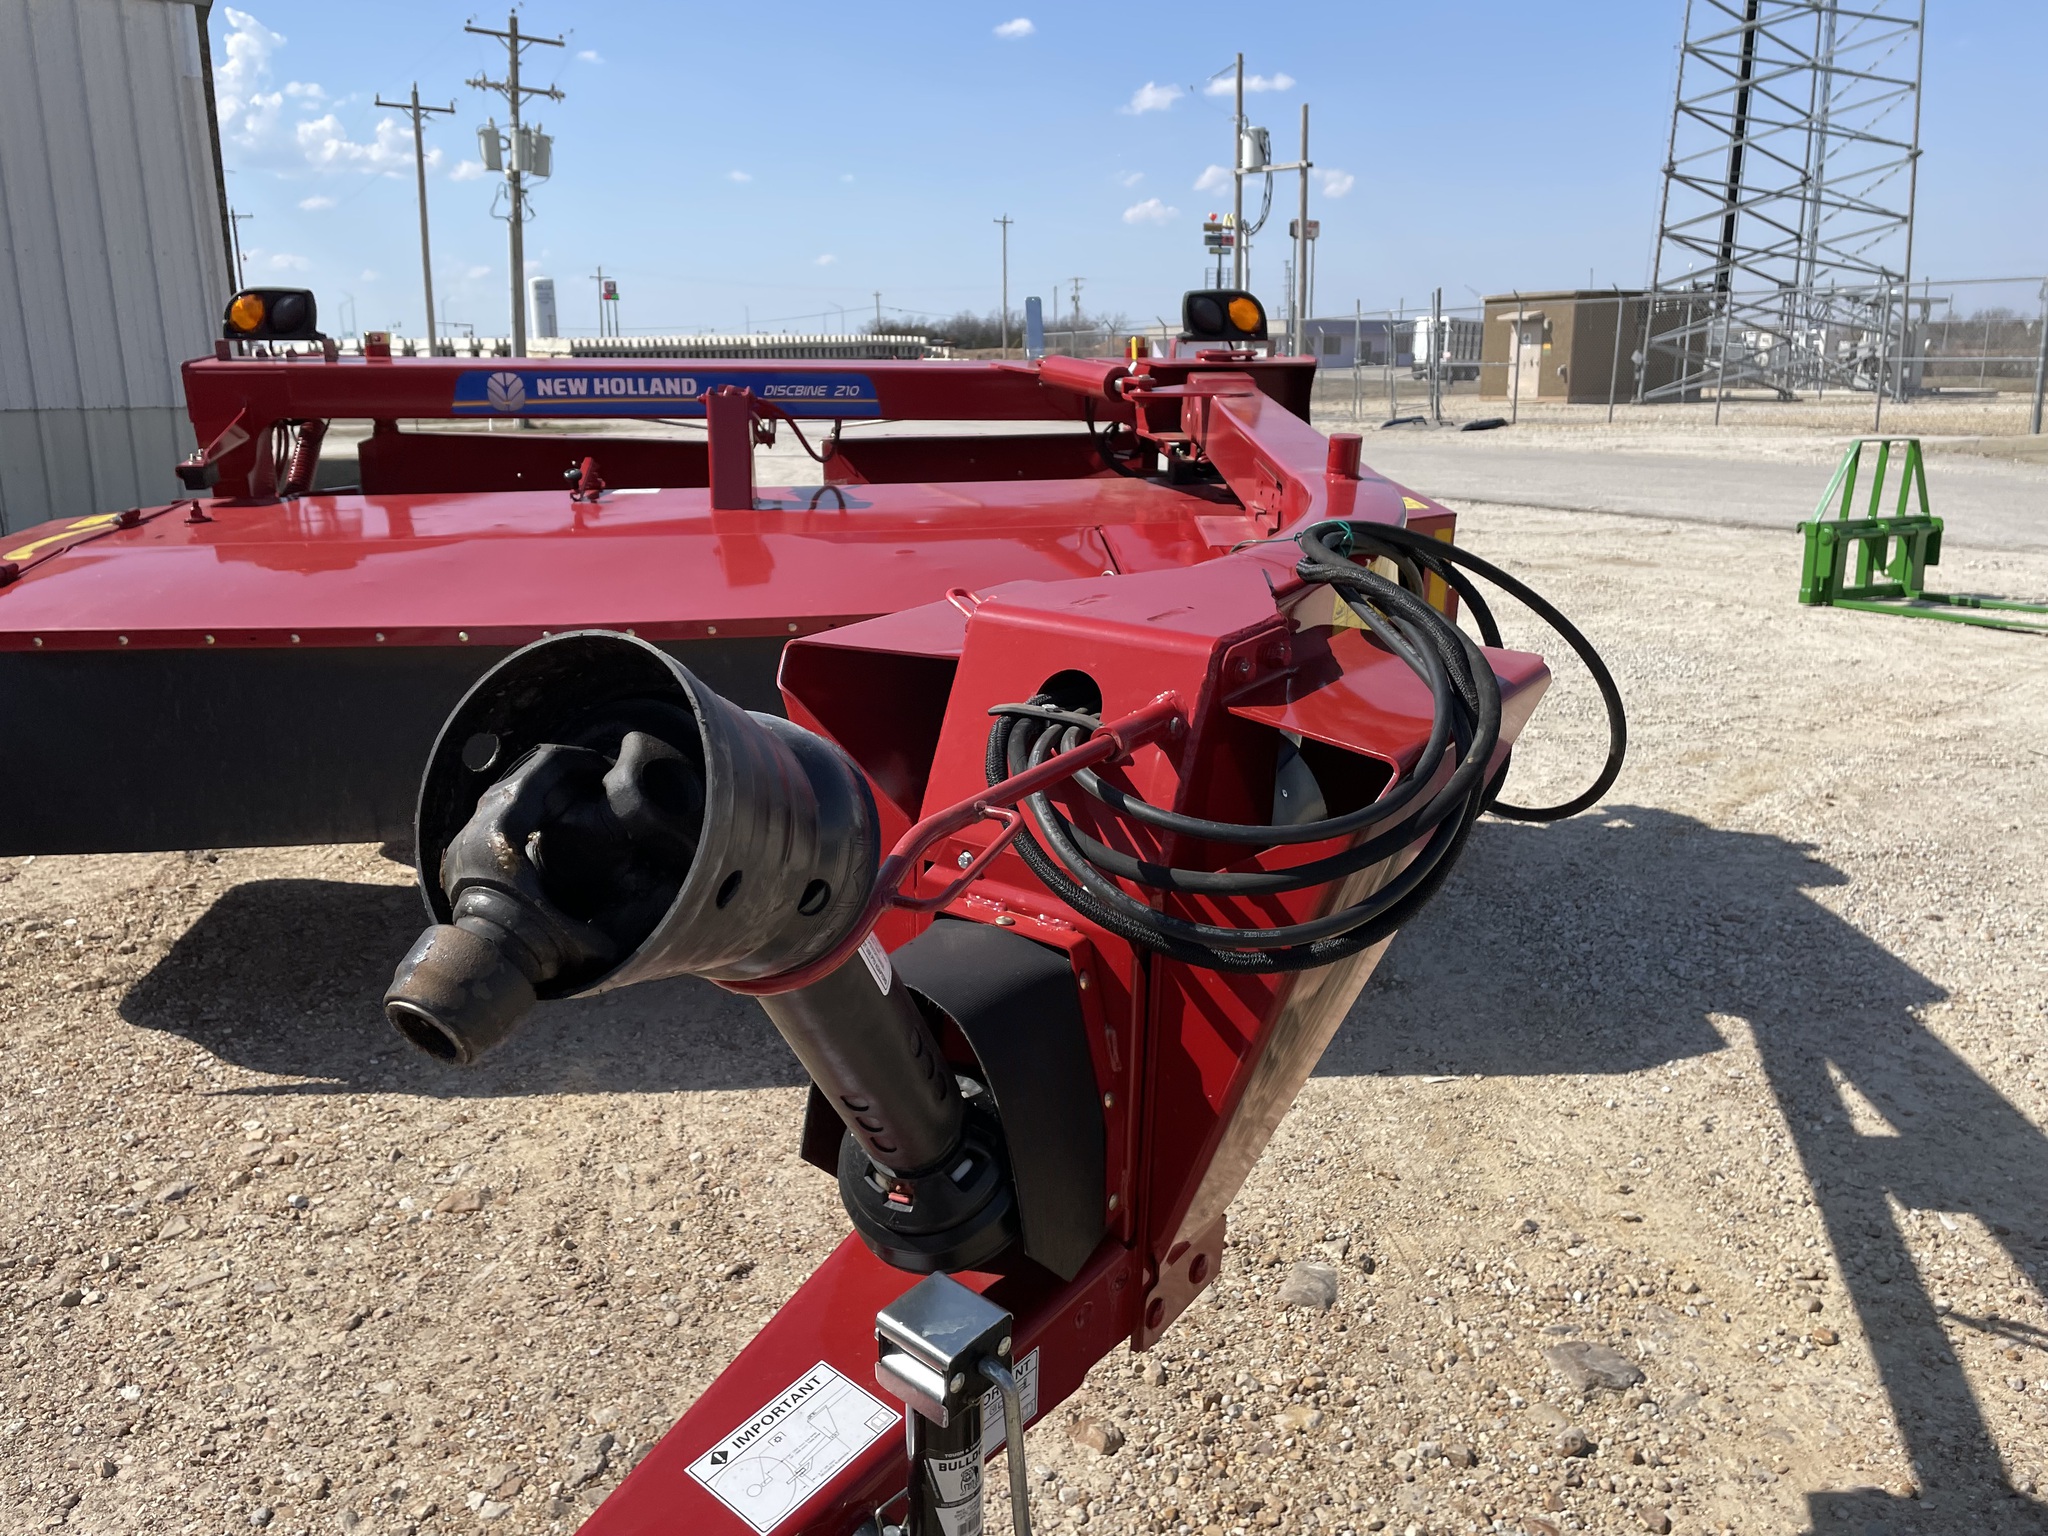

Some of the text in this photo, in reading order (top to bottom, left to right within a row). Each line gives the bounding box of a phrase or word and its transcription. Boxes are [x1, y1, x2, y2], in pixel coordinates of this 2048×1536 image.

[536, 377, 698, 396] NEW HOLLAND
[763, 384, 860, 397] DISCBINE 210
[731, 1375, 822, 1449] IMPORTANT
